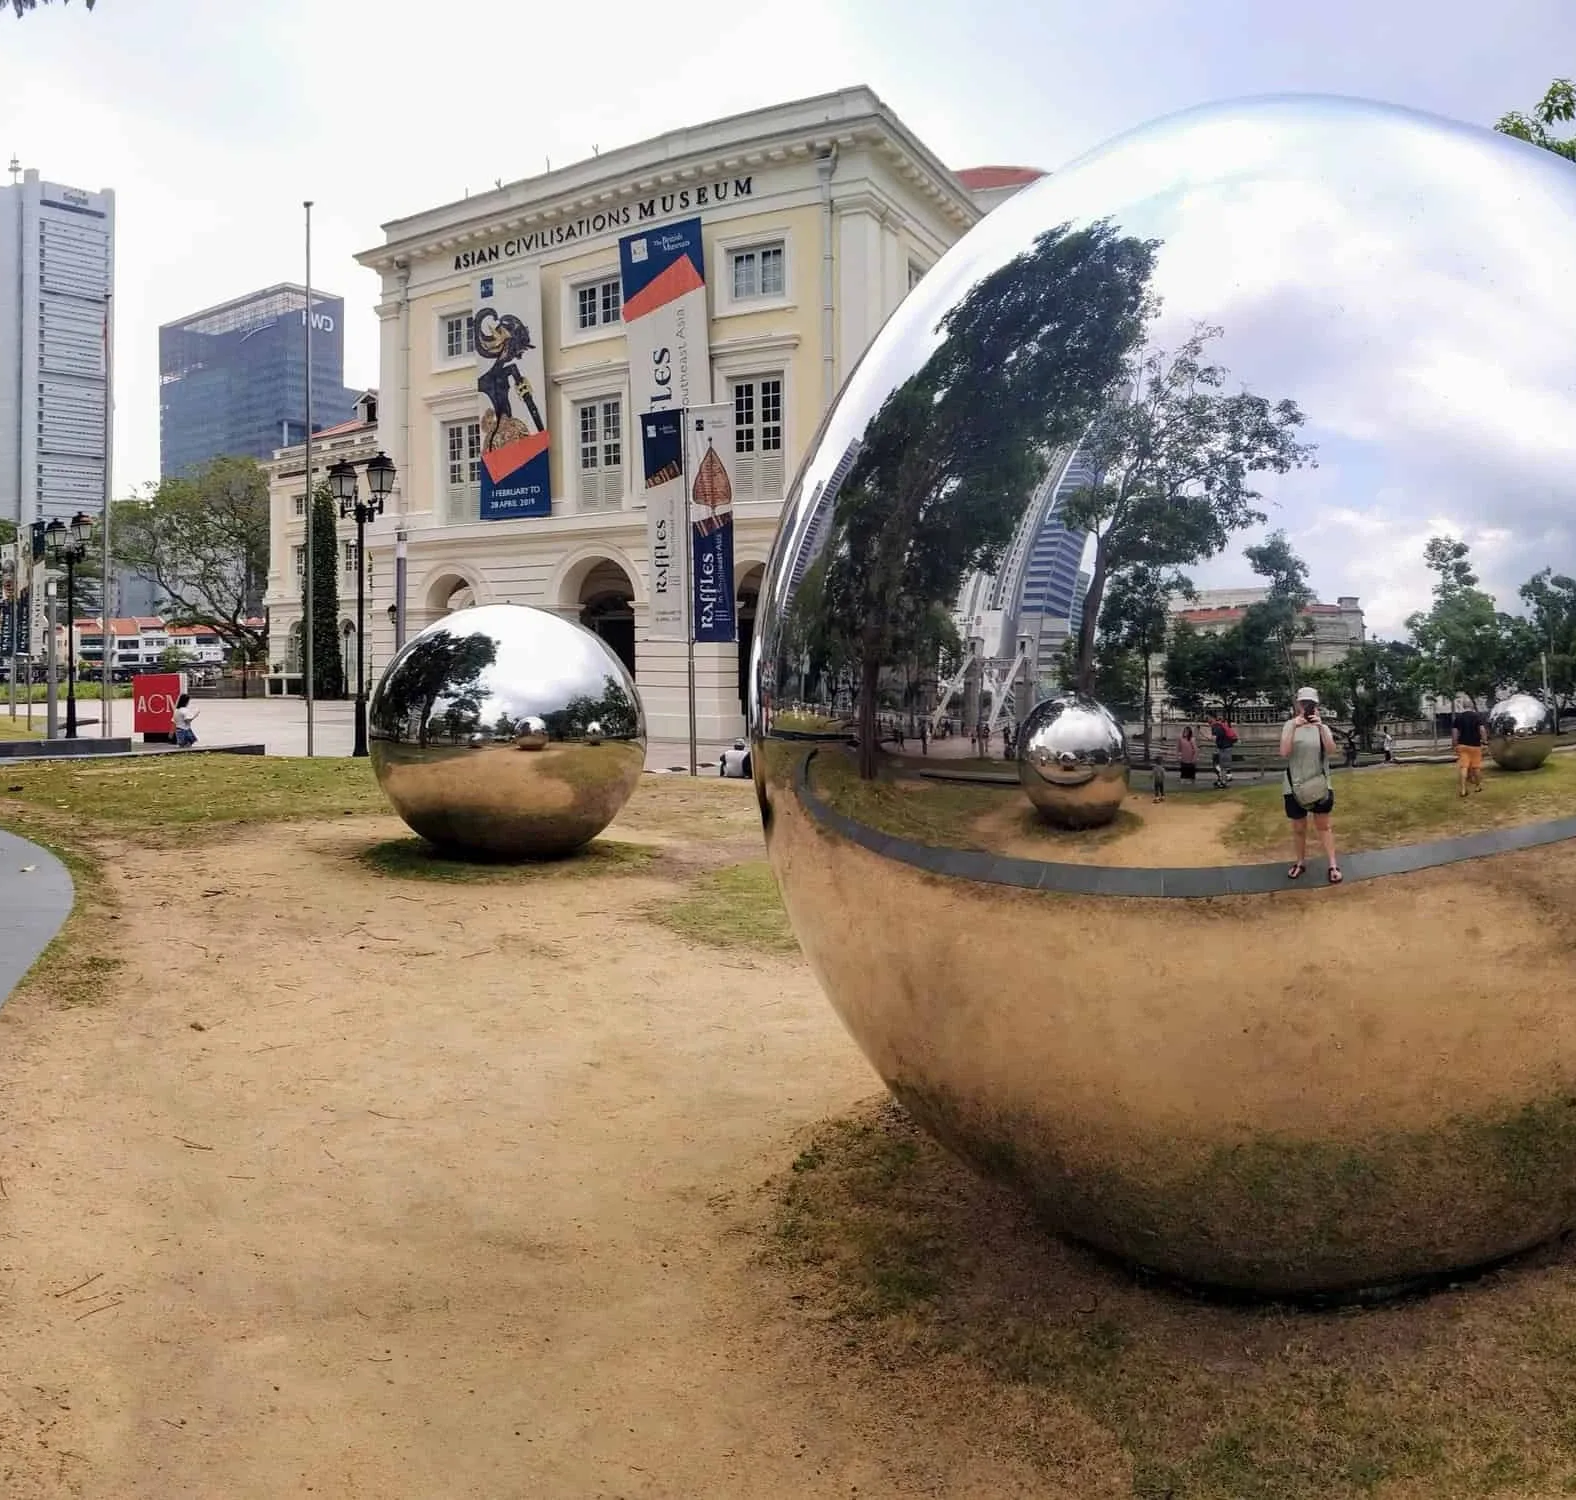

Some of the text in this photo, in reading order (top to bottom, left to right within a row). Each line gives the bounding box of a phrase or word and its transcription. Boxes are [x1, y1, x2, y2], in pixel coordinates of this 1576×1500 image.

[454, 244, 499, 270] ASIAN
[504, 207, 630, 257] CIVILISATIONS
[638, 176, 753, 220] MUSEUM
[529, 486, 541, 494] TO
